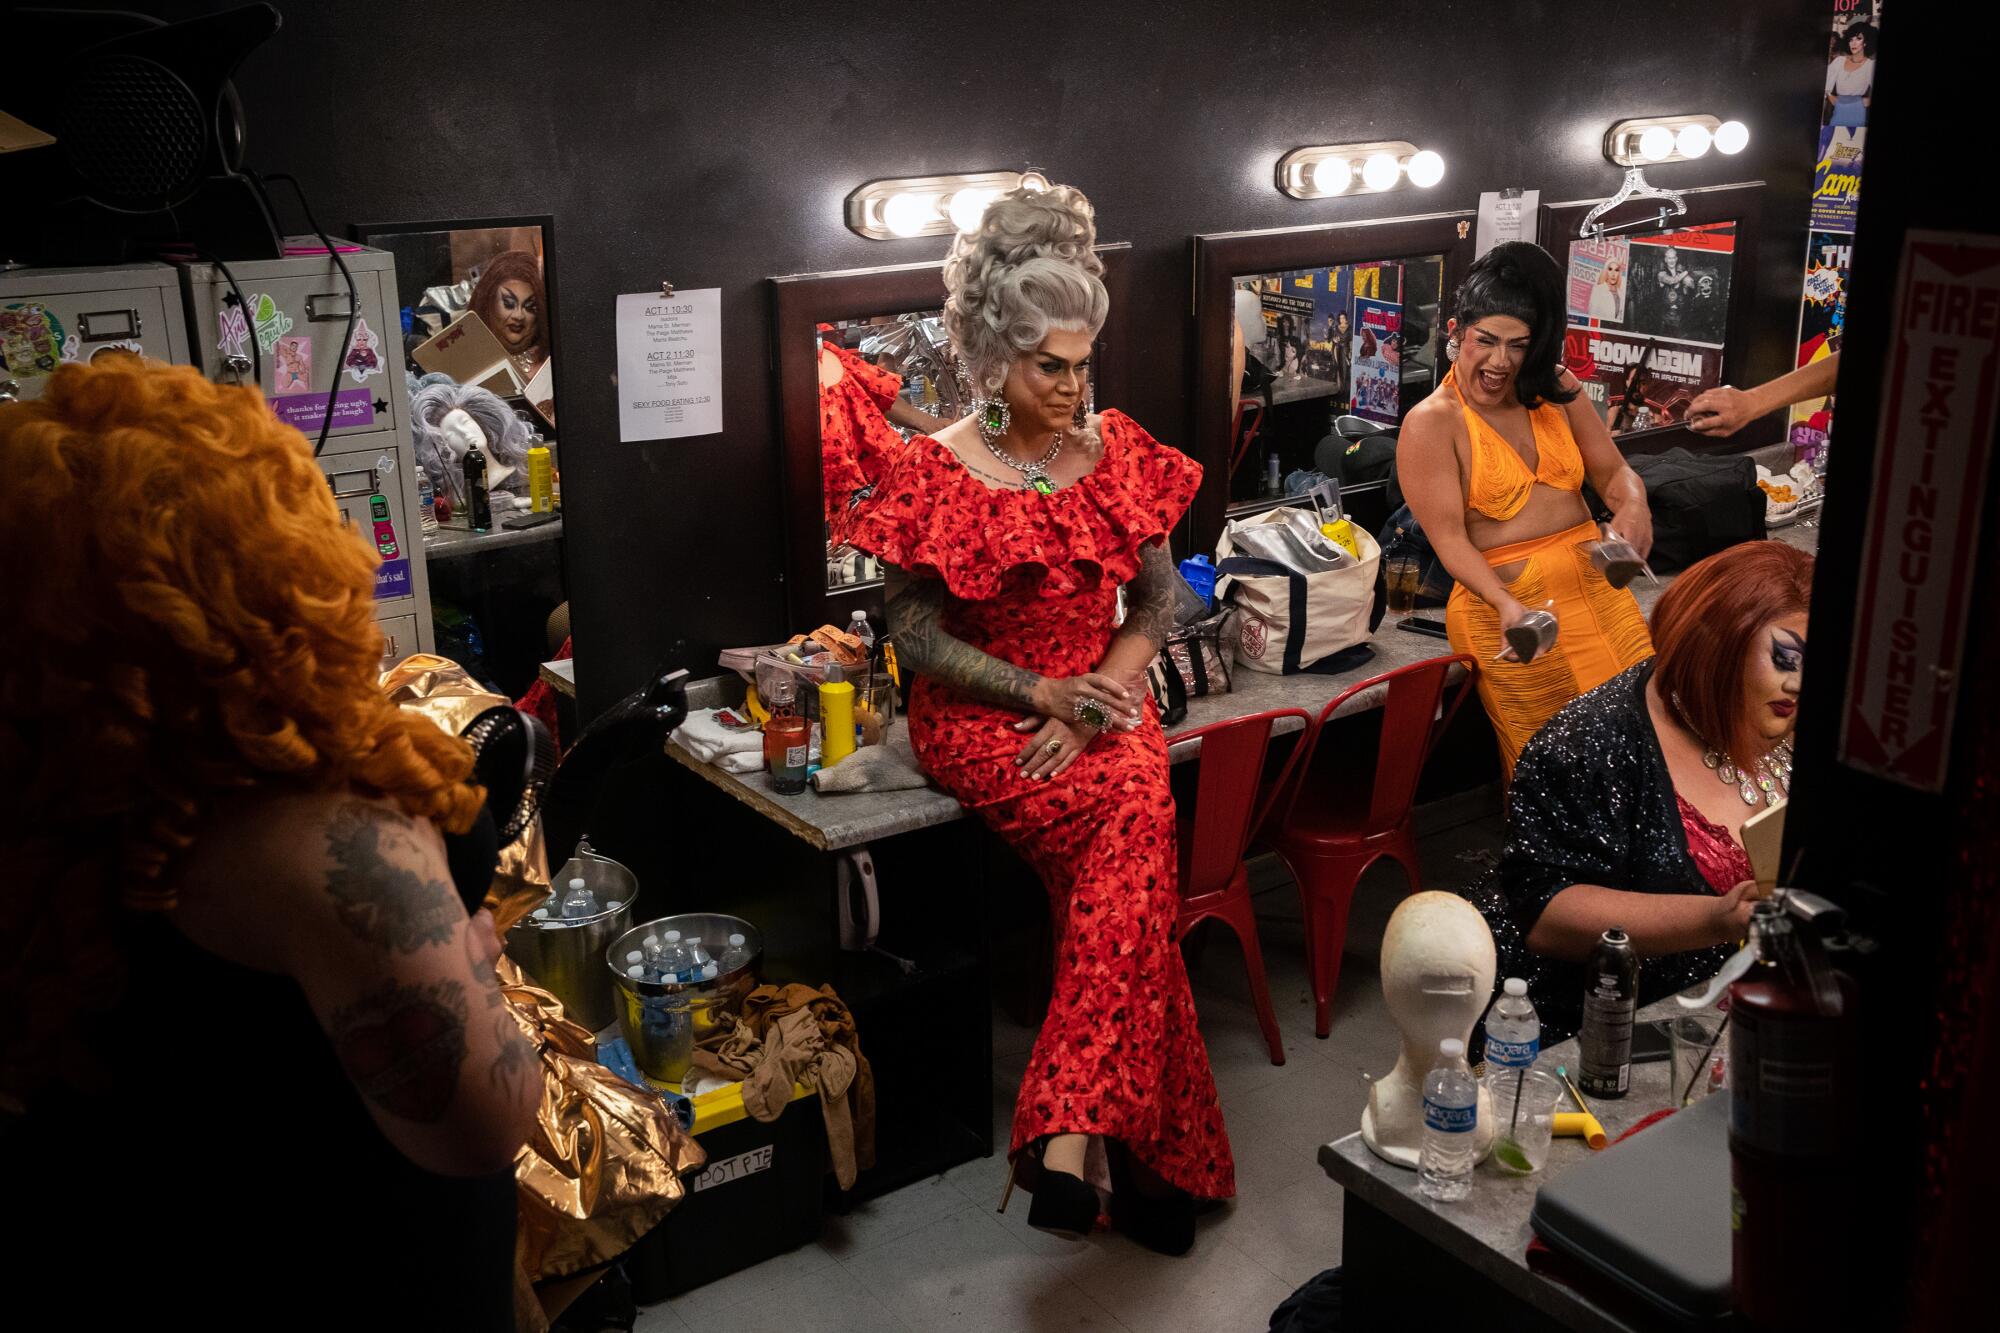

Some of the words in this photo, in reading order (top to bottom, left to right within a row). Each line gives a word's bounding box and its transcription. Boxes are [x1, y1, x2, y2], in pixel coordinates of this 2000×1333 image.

[645, 306, 663, 316] ACT
[672, 304, 693, 314] 10:30
[1909, 280, 1999, 338] FIRE
[647, 351, 665, 361] ACT
[666, 351, 672, 360] 2
[674, 349, 695, 359] 11:30
[286, 405, 313, 415] thanks
[314, 403, 328, 412] for
[632, 401, 651, 410] SEXY
[651, 399, 671, 408] FOOD
[293, 413, 301, 421] it
[1880, 346, 1960, 750] EXTINGUISHER
[375, 570, 393, 585] that's
[392, 569, 406, 583] sad.
[1242, 630, 1264, 651] TRADER
[698, 1158, 737, 1188] POT
